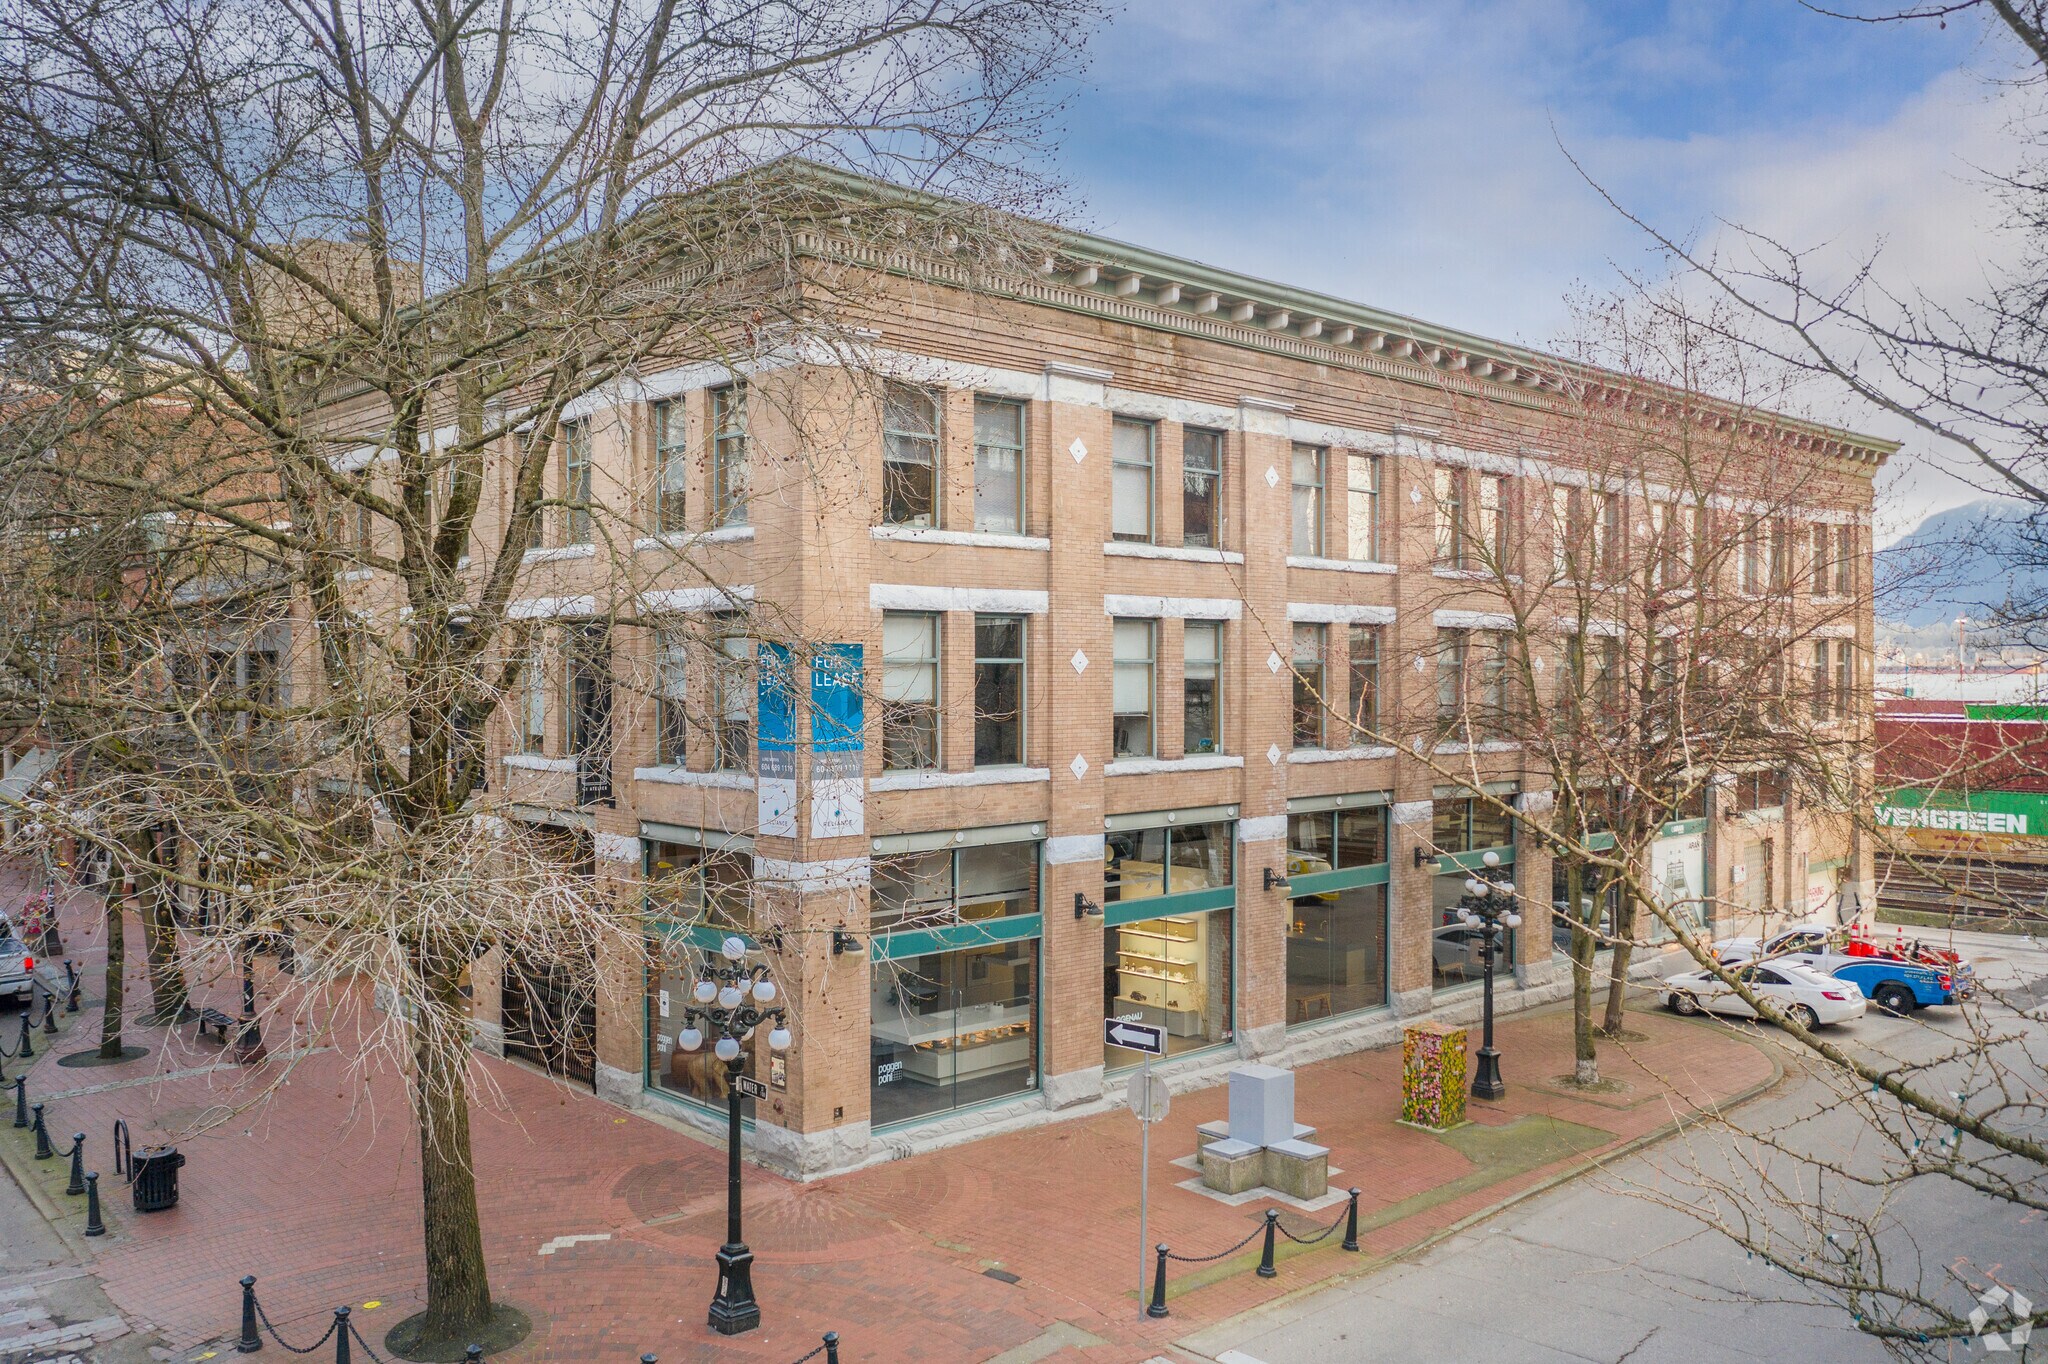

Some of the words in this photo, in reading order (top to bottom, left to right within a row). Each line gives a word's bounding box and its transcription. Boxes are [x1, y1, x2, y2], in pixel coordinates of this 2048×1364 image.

[815, 672, 860, 687] LEASE
[823, 819, 853, 828] RELIANCE
[656, 1033, 673, 1045] poggen
[878, 1060, 903, 1075] poggen
[878, 1072, 893, 1087] pohl
[742, 1080, 758, 1095] WATER
